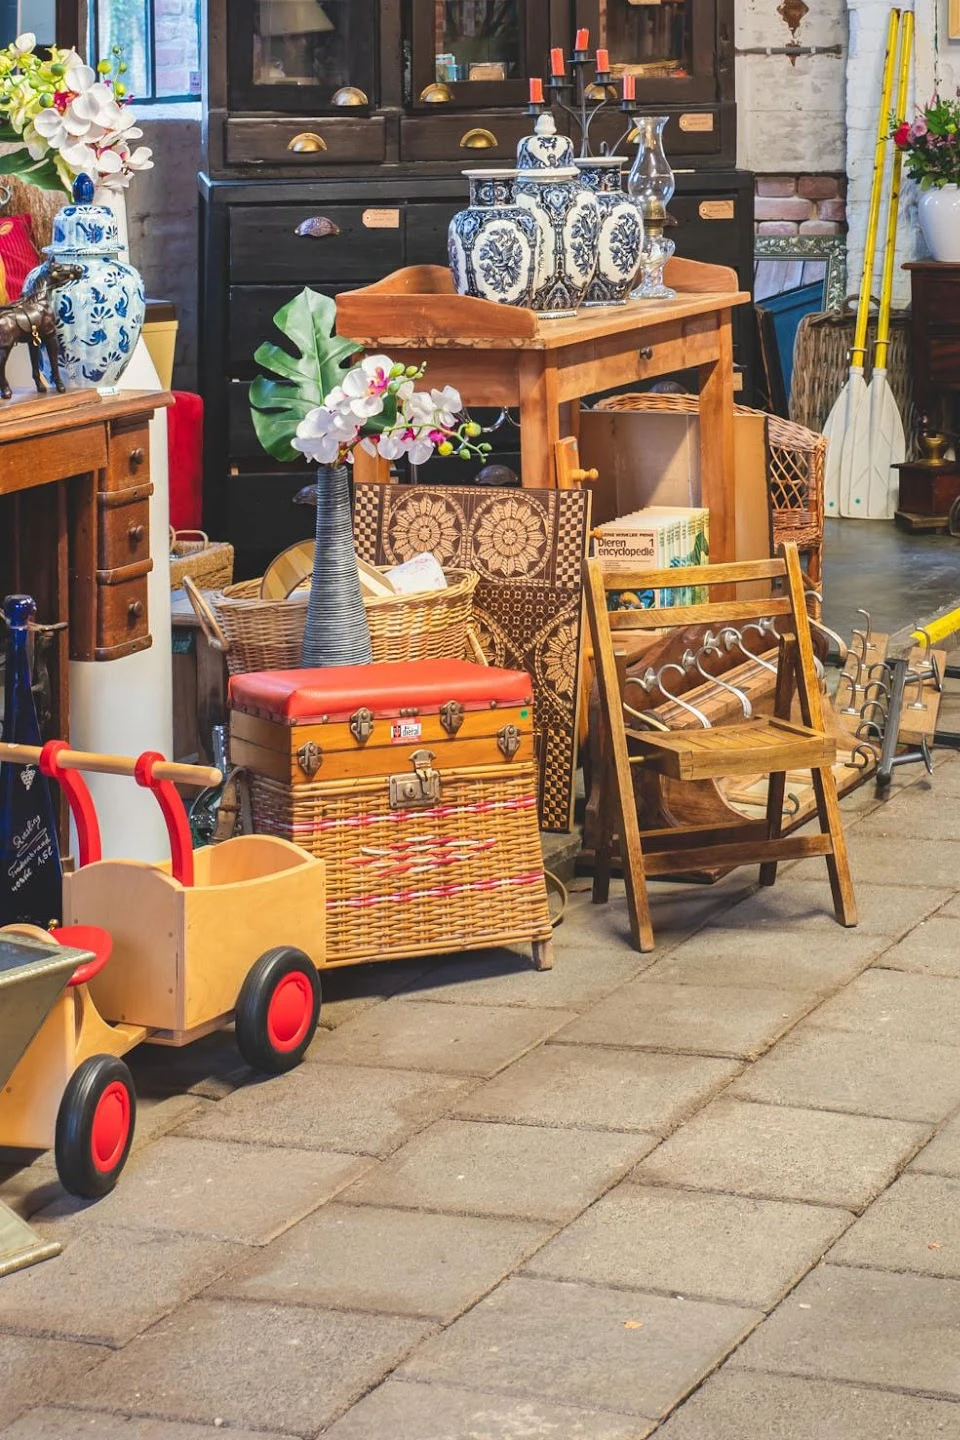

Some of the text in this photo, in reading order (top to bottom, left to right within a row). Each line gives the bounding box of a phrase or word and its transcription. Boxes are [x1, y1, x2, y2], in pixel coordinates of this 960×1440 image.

[598, 538, 654, 547] Dieren 1
[598, 547, 654, 557] encyclopedie
